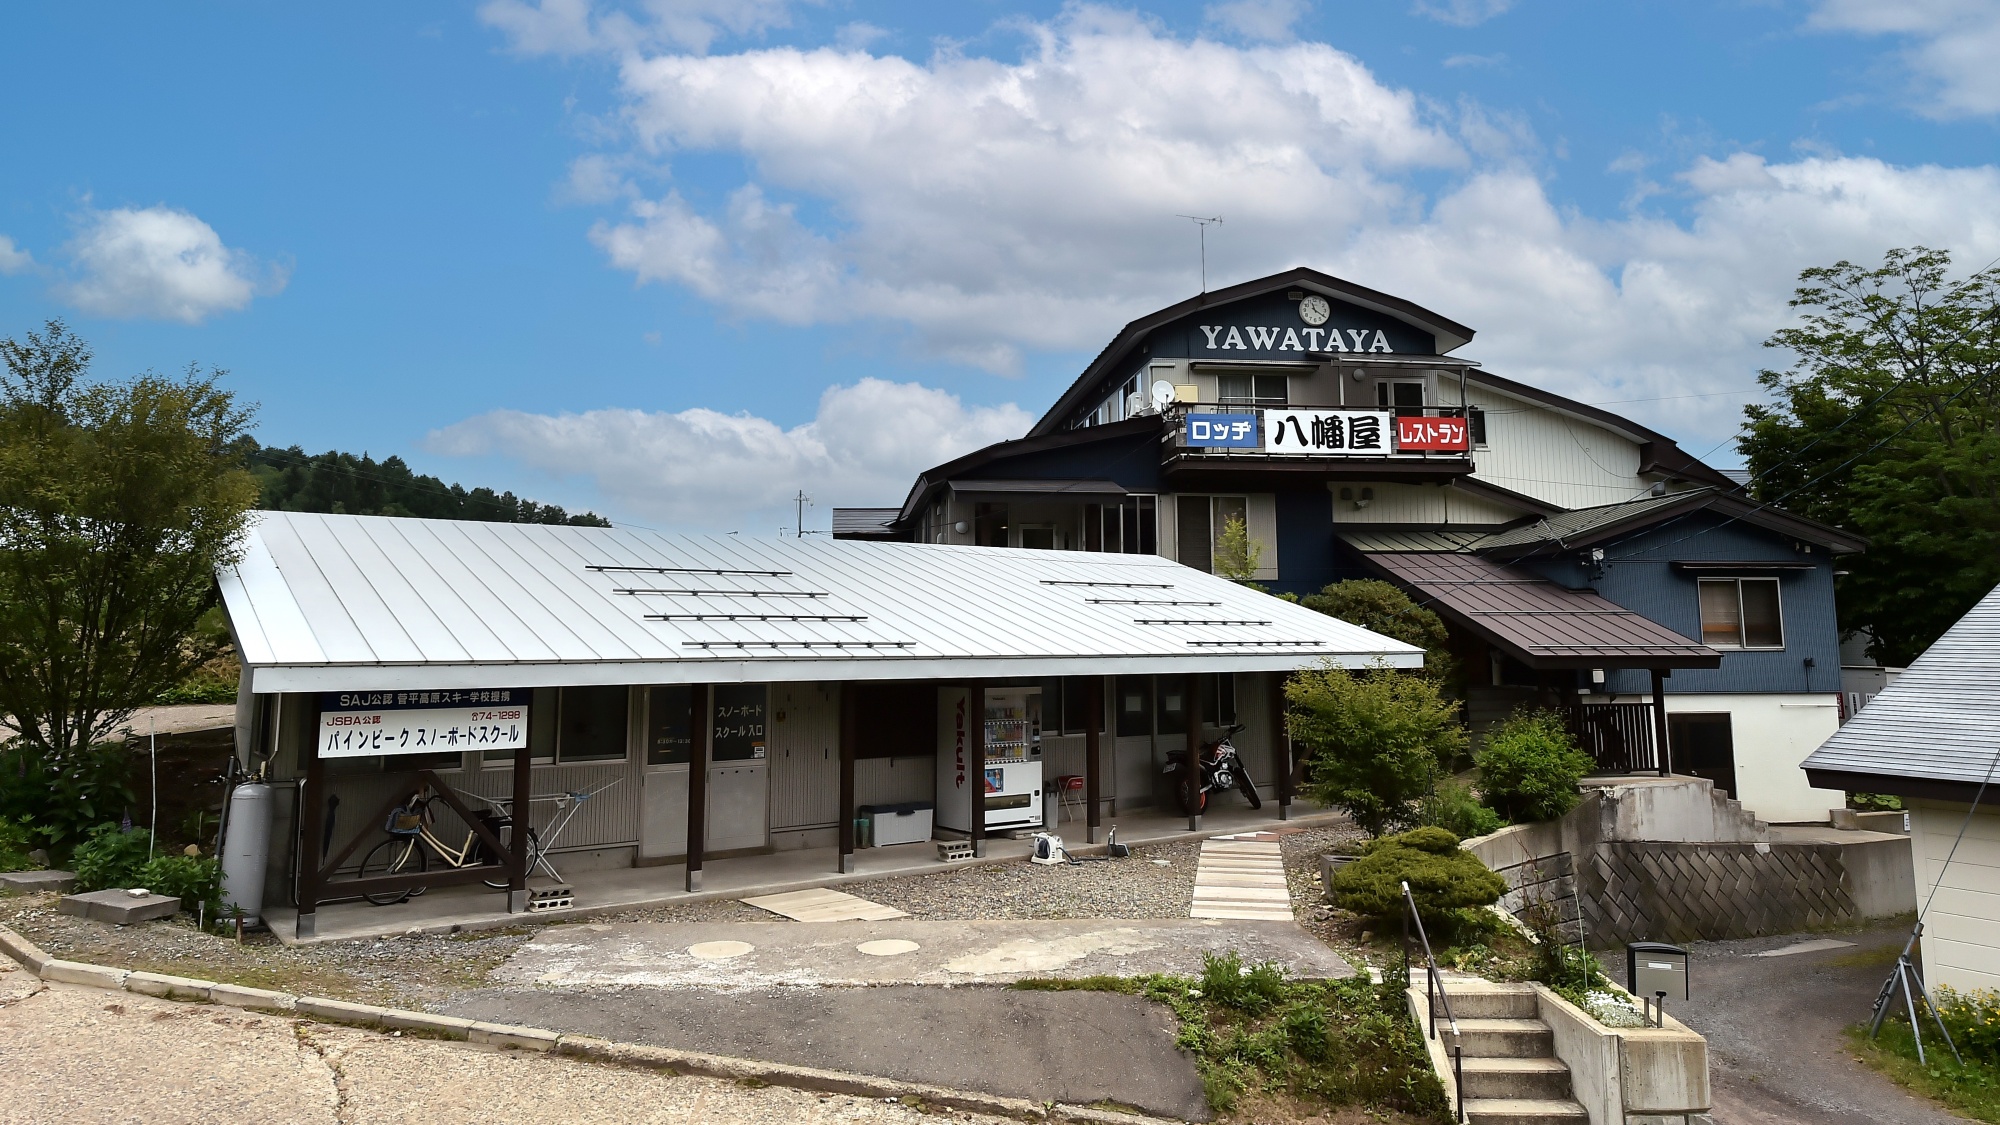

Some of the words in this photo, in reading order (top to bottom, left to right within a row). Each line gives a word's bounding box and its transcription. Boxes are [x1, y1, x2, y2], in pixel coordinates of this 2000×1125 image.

[1200, 325, 1393, 354] YAWATAYA
[1192, 421, 1252, 440] ロッヂ
[1275, 415, 1381, 450] 八幡屋
[1399, 422, 1464, 444] レストラン
[339, 693, 393, 706] SAJ公認
[326, 715, 381, 726] JSBA公認
[718, 704, 762, 717] スノーボード
[416, 724, 519, 747] スノーボードスクール
[715, 725, 746, 739] スクール
[748, 724, 763, 737] 入口
[955, 696, 966, 790] Yakult
